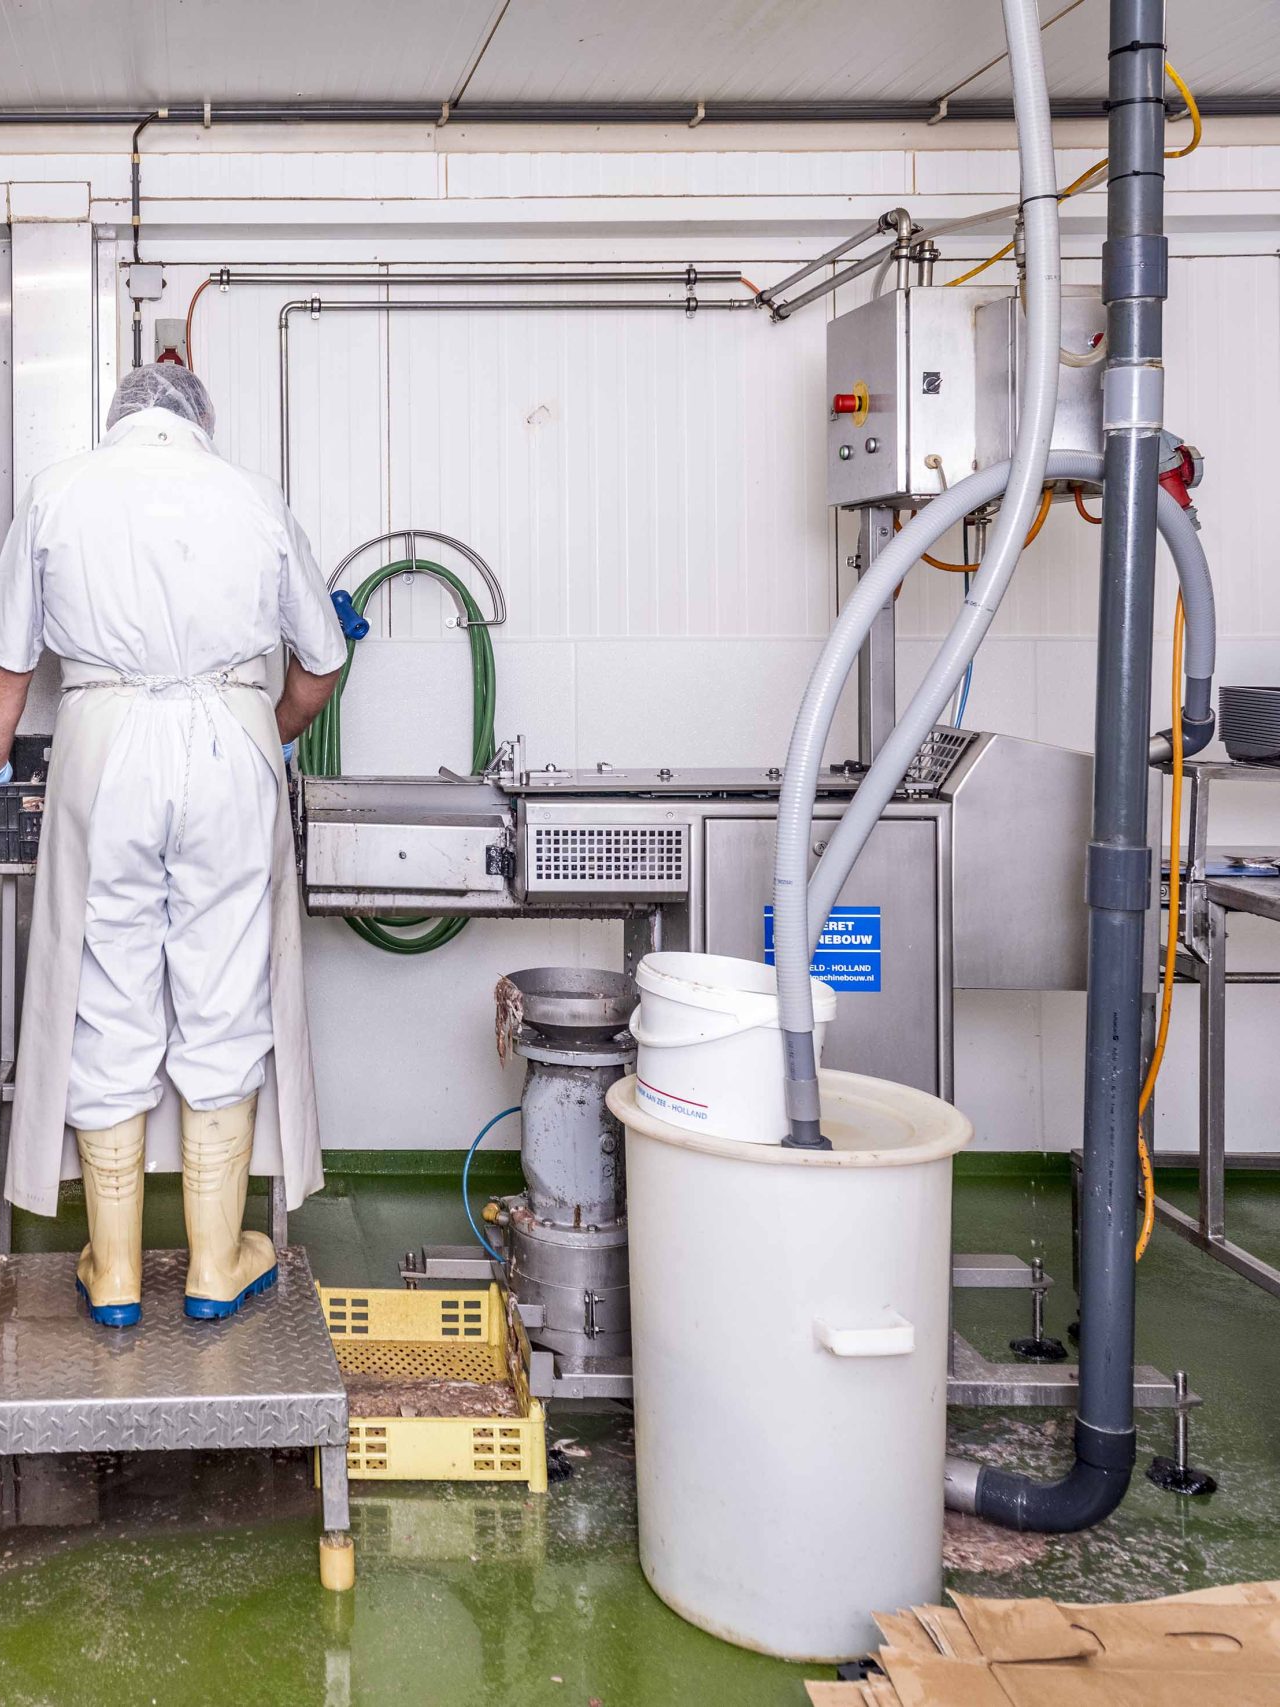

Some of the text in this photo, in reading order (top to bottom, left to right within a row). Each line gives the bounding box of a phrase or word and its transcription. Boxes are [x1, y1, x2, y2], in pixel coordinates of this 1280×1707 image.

[823, 921, 855, 931] ERET
[818, 934, 873, 945] NEBOUW
[809, 964, 826, 972] ELD
[831, 964, 872, 972] HOLLAND
[810, 974, 875, 982] machinebouw.nl
[656, 1097, 667, 1107] ZEE
[671, 1103, 708, 1120] HOLLAND
